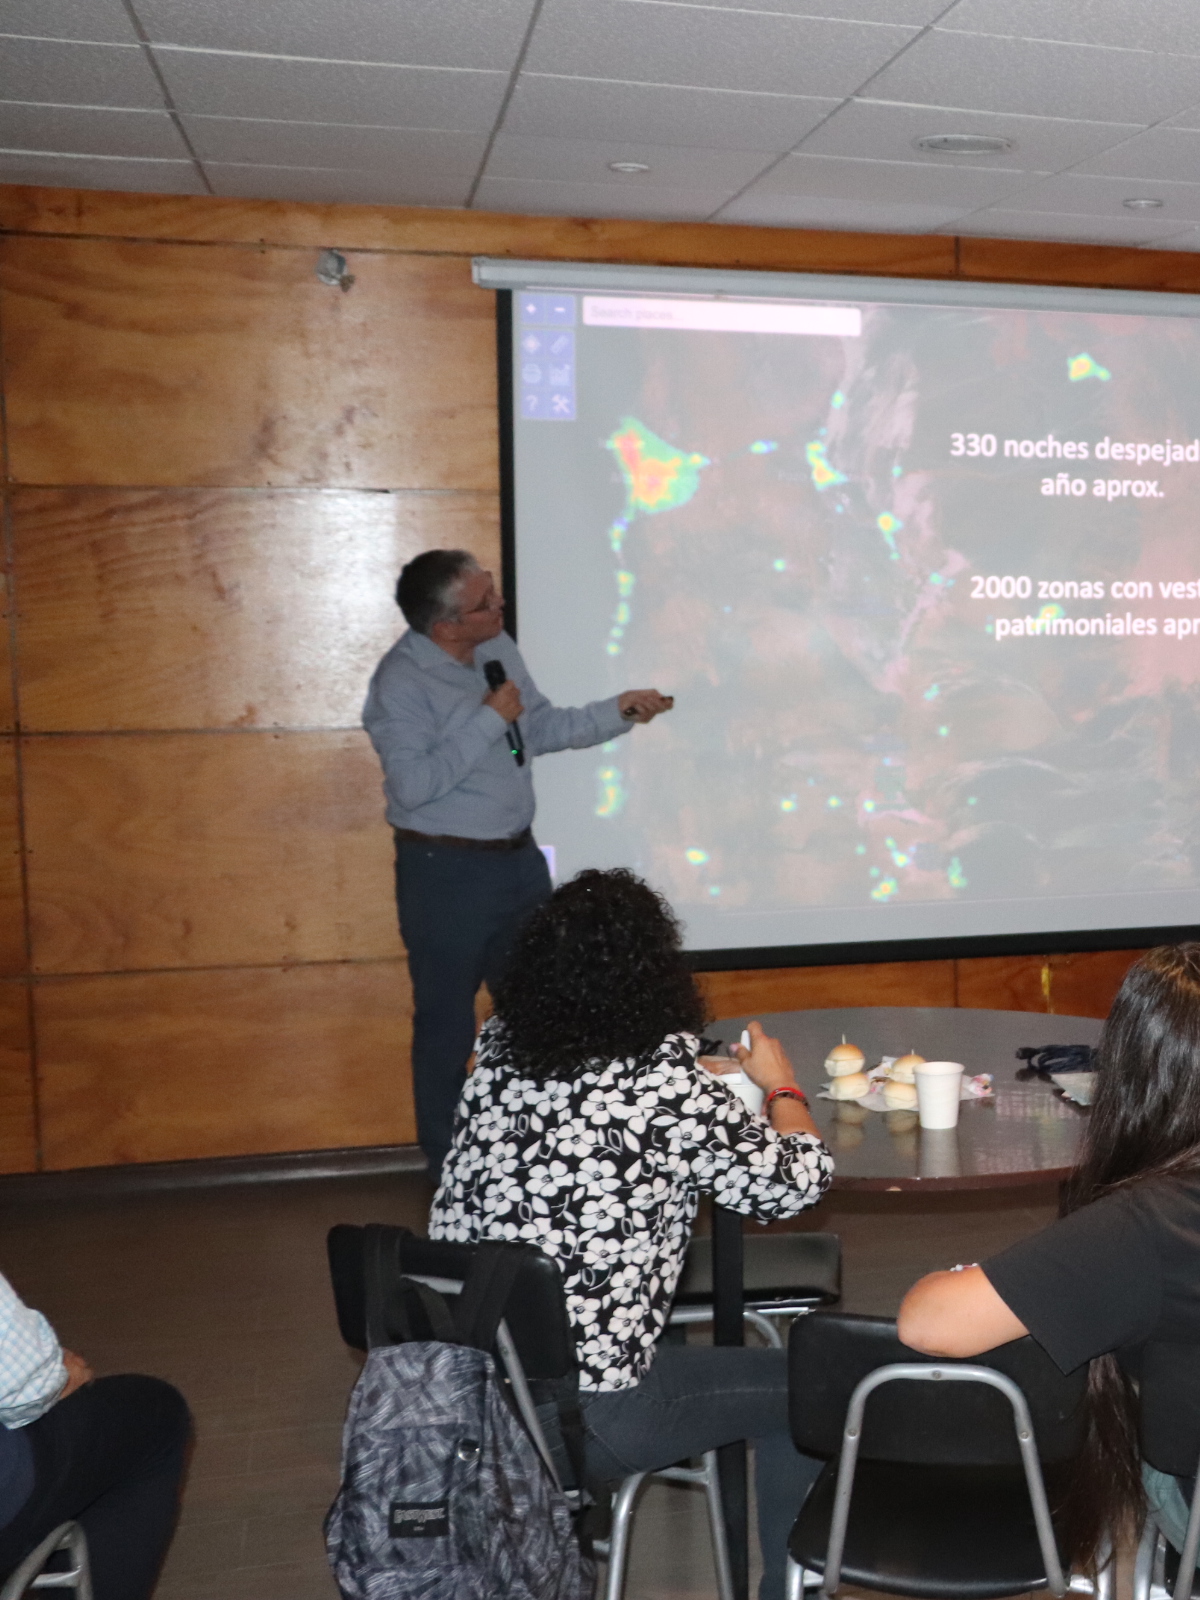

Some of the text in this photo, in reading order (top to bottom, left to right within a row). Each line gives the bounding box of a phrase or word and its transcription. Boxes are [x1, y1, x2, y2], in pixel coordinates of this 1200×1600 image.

[951, 433, 997, 457] 330
[1004, 434, 1089, 459] noches
[1041, 473, 1165, 501] año aprox.
[970, 576, 1032, 599] 2000
[1038, 580, 1104, 599] zonas
[1111, 580, 1153, 599] con
[995, 612, 1158, 641] patrimoniales
